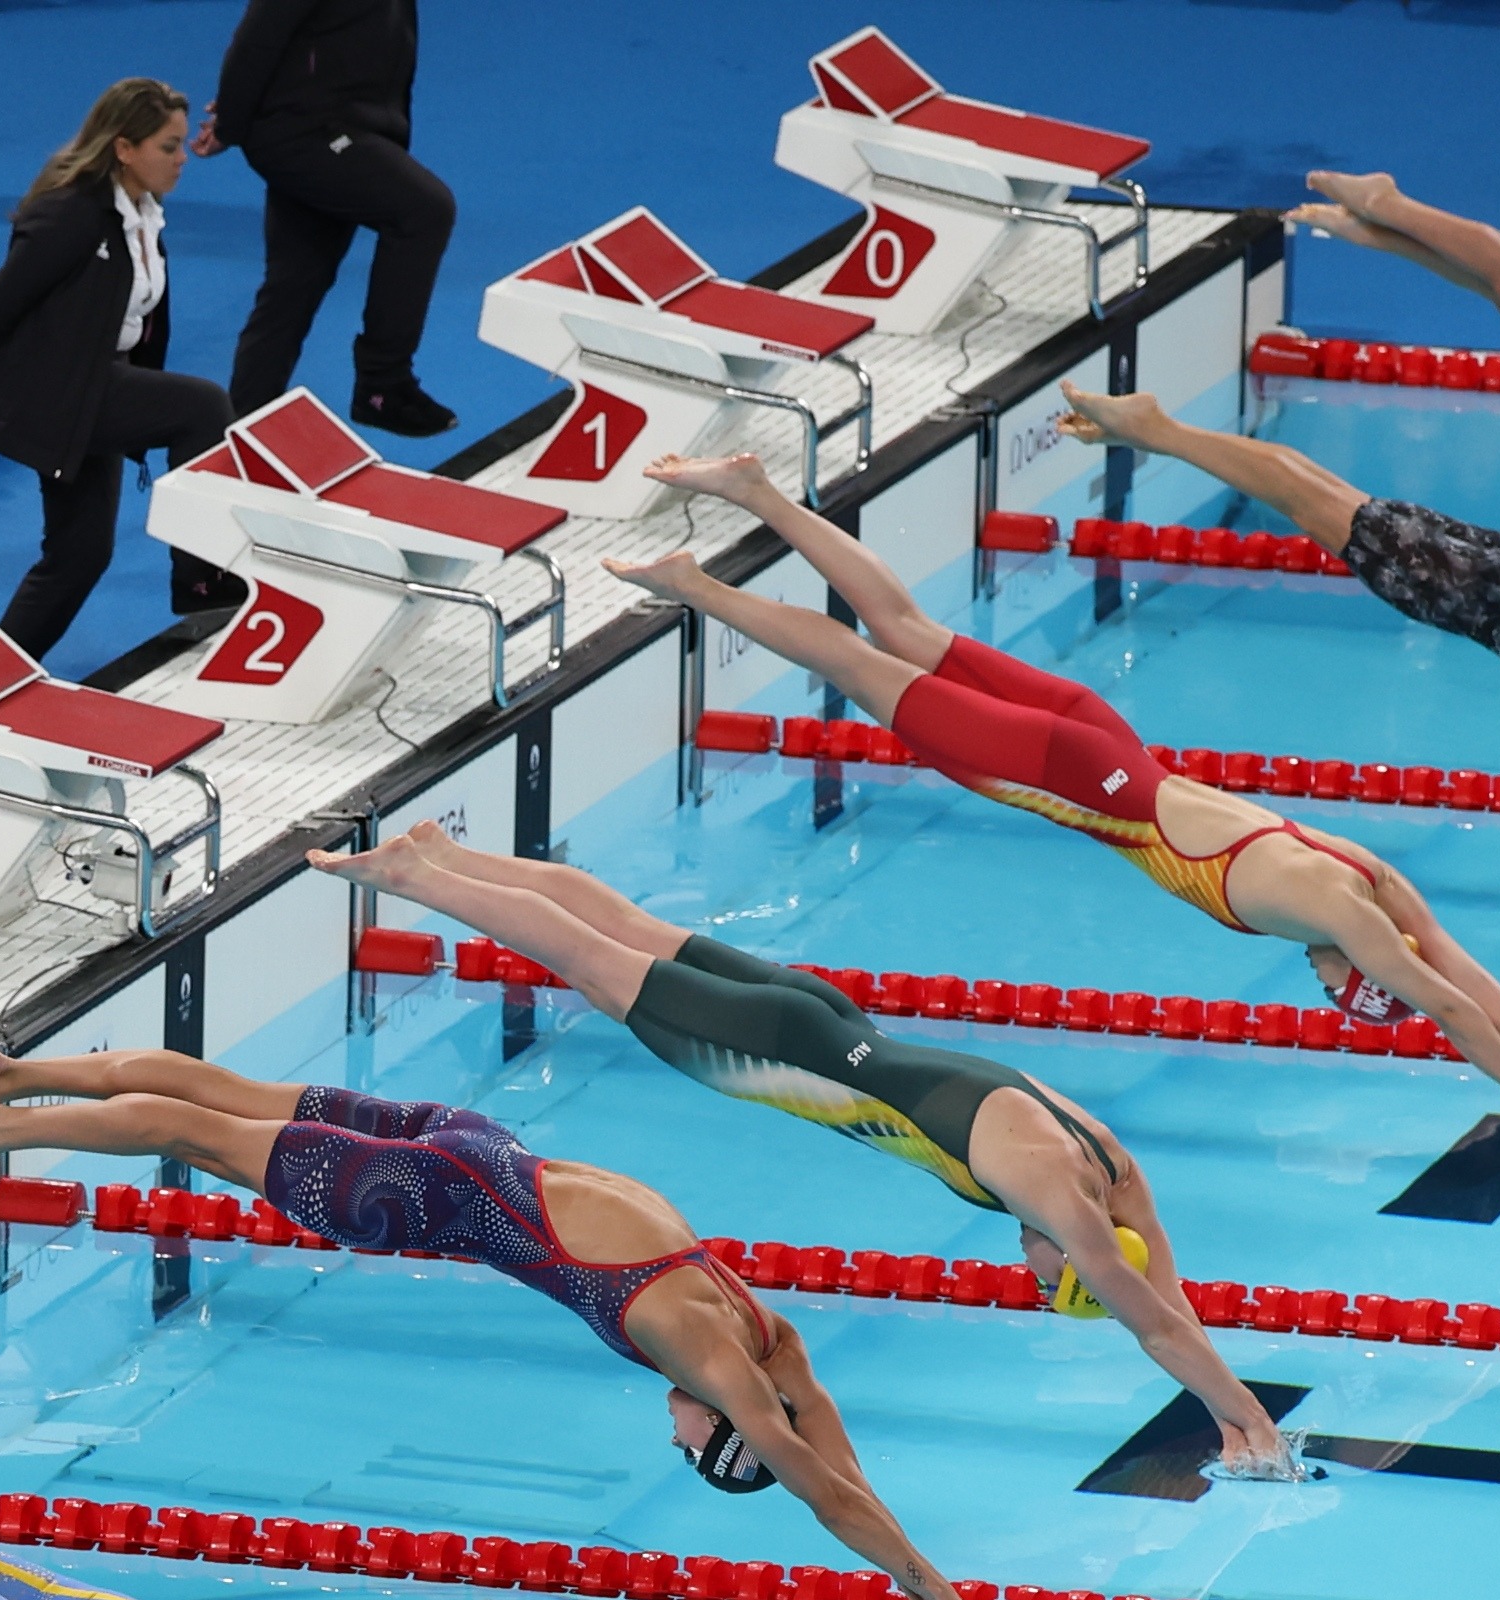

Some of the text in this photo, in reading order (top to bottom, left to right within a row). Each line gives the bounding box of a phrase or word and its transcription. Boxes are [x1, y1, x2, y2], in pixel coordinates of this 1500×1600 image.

[866, 229, 905, 288] 0
[583, 411, 607, 470] 1
[244, 610, 285, 672] 2
[847, 1040, 872, 1067] AUS
